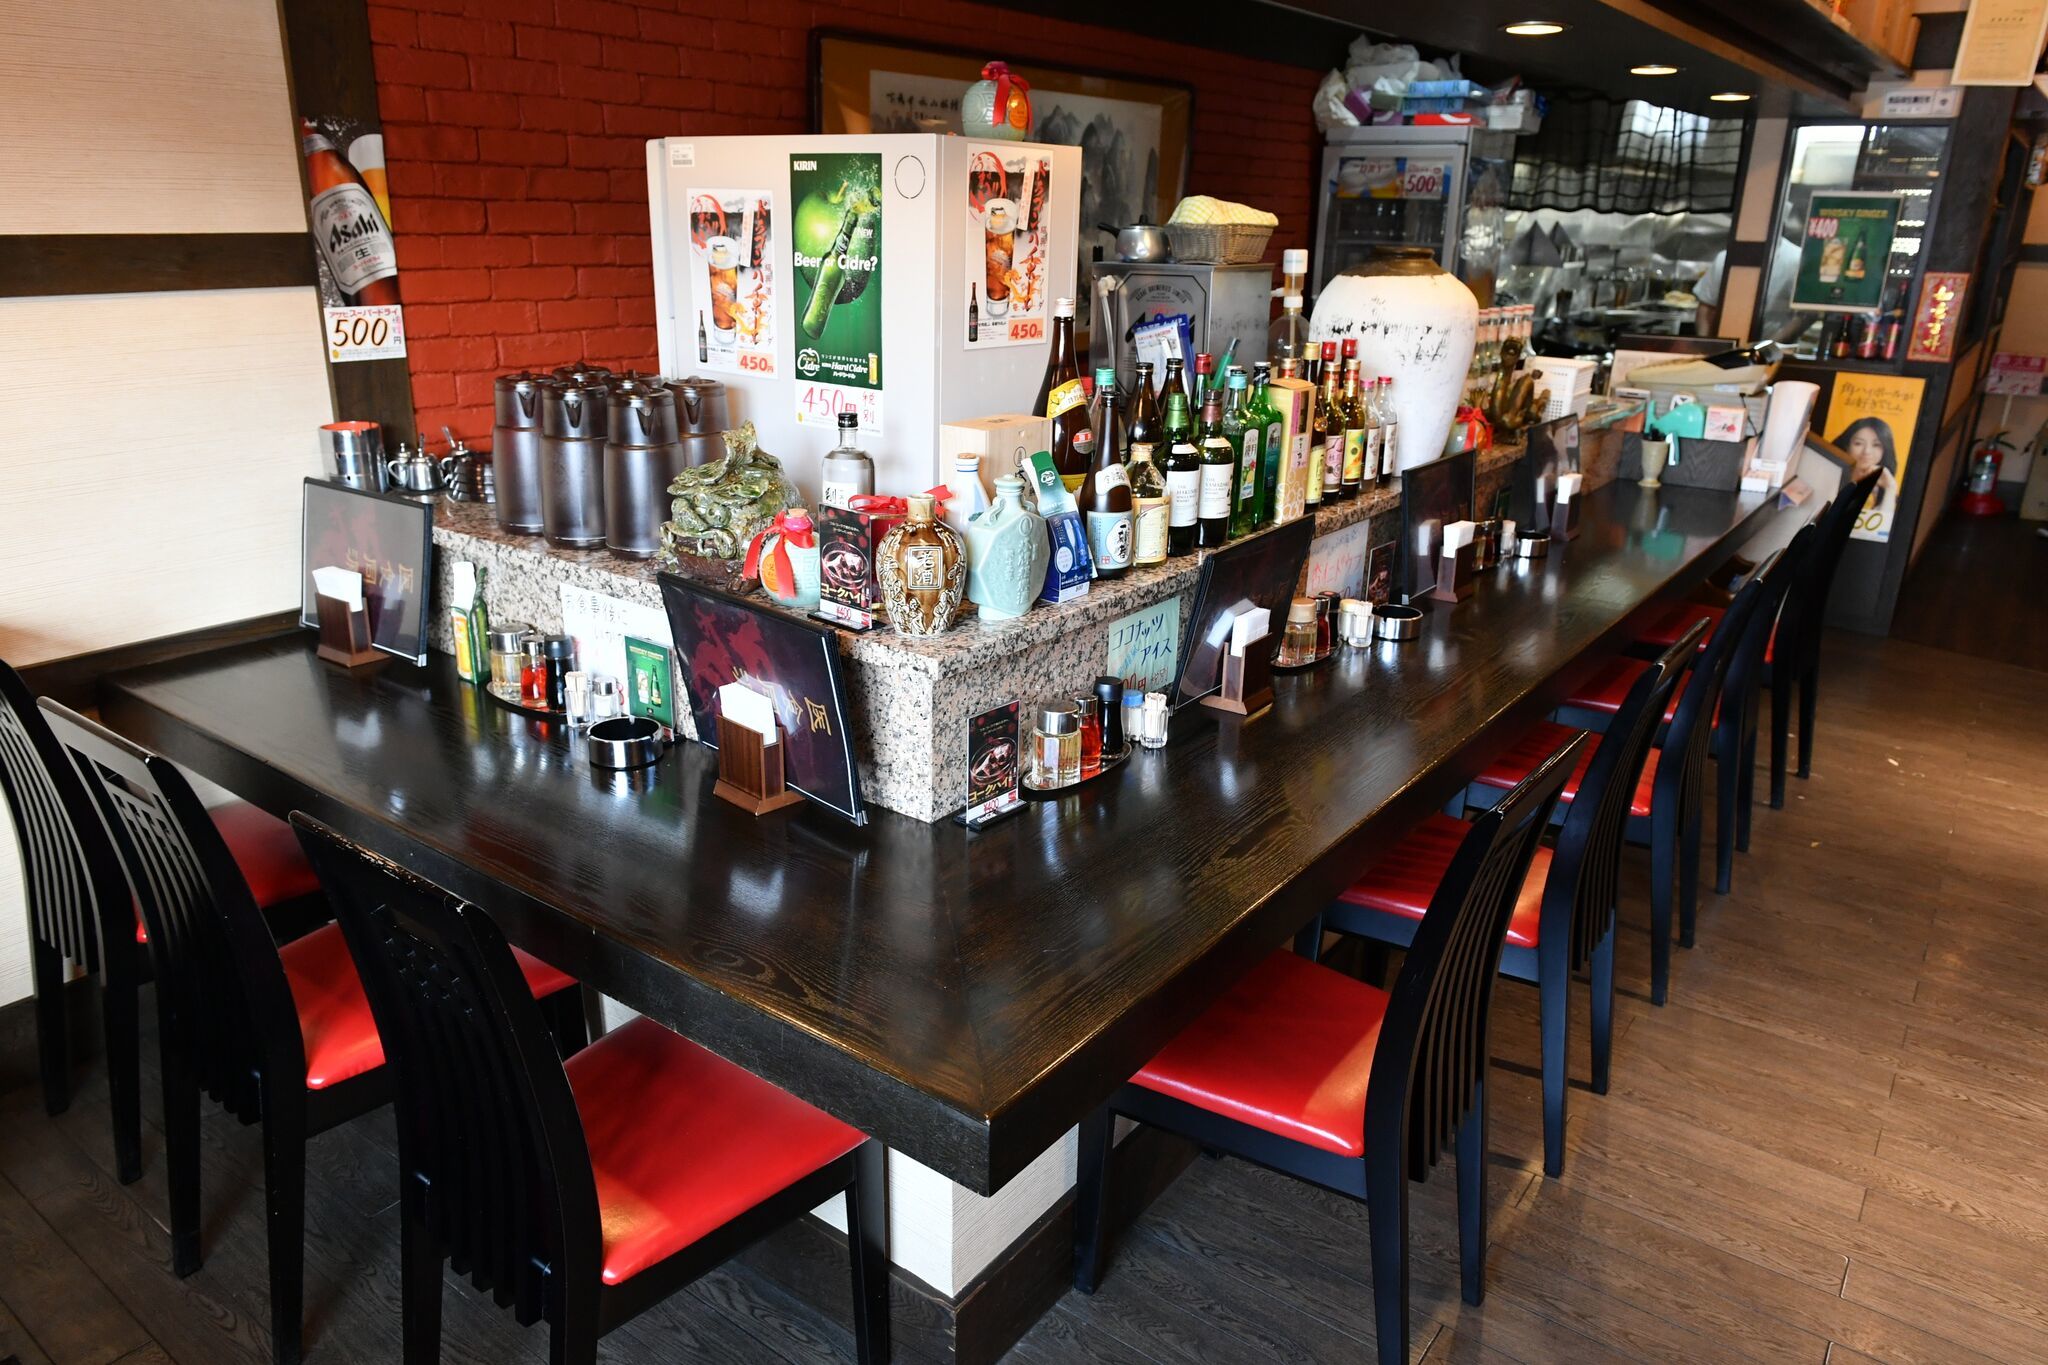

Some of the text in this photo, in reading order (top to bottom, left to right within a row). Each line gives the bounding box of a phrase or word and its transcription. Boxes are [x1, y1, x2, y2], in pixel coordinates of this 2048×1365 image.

[793, 160, 817, 171] KIRIN
[1406, 174, 1436, 193] 500
[329, 212, 380, 254] Asahi
[1808, 217, 1839, 239] ¥400
[355, 247, 371, 260] 生
[794, 251, 878, 272] Beer or Cidre?
[333, 317, 388, 347] 500
[393, 336, 402, 345] 円
[740, 355, 774, 374] 450円
[821, 582, 862, 604] コークハイ
[1112, 613, 1164, 651] ココナッツ
[1140, 639, 1172, 666] アイス
[968, 776, 1009, 802] コークハイ
[983, 797, 1000, 814] ¥400
